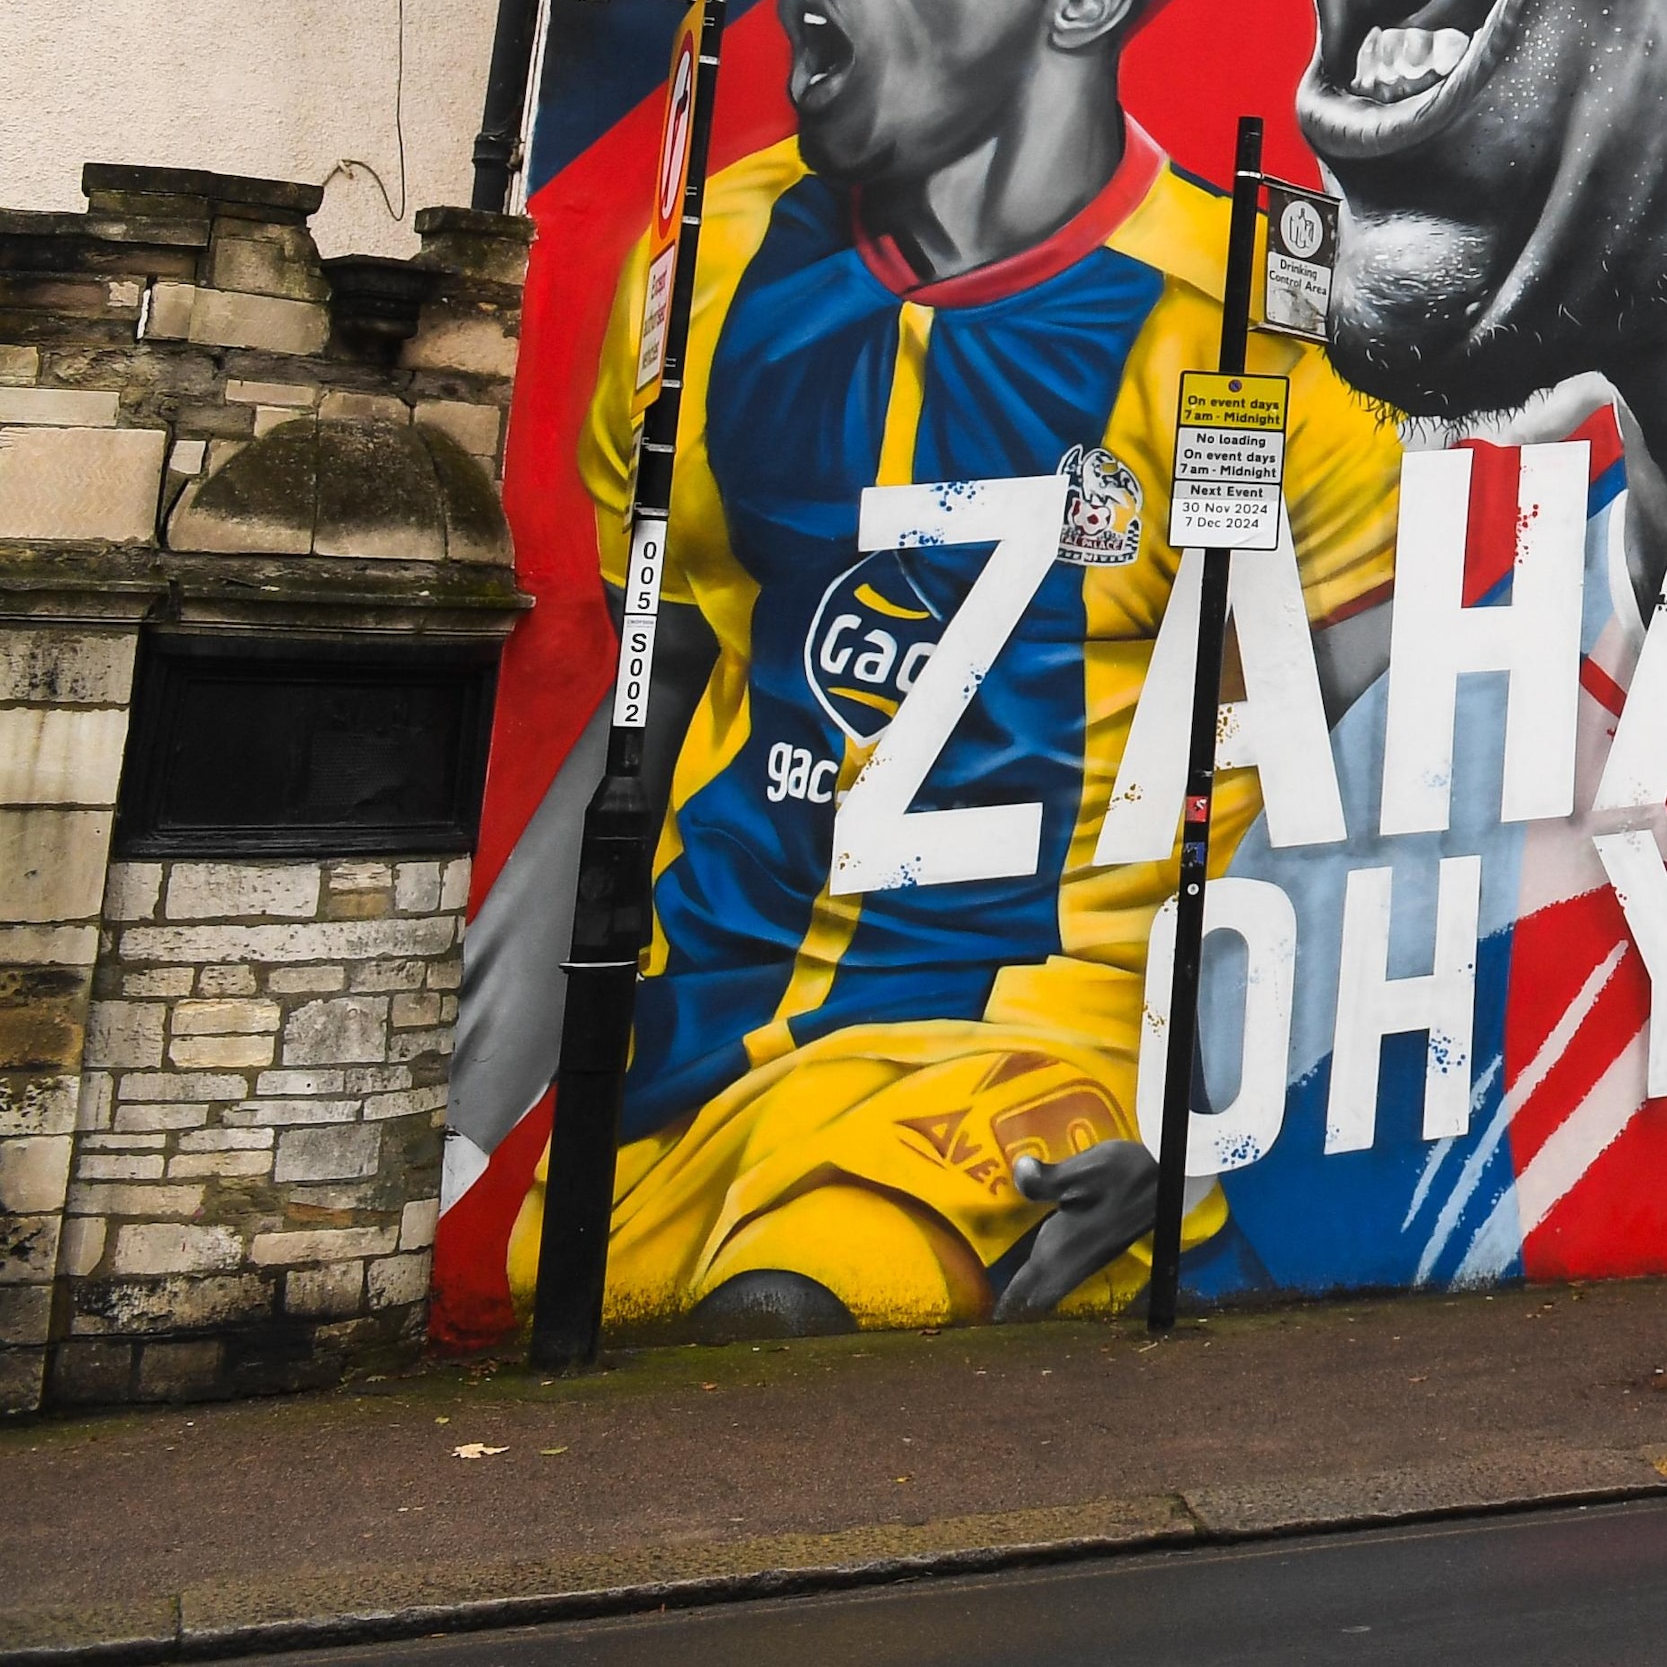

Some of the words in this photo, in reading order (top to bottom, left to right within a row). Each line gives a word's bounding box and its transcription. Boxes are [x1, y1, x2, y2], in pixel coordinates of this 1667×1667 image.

[1280, 259, 1318, 281] Drinking
[1269, 270, 1302, 289] Control
[1305, 281, 1327, 296] Area
[1187, 395, 1206, 406] On
[1210, 397, 1246, 409] event
[1250, 399, 1280, 412] days
[1224, 412, 1281, 426] Midnight
[1196, 432, 1215, 445] No
[1219, 433, 1267, 449] loading
[1184, 448, 1202, 461] On
[1206, 450, 1243, 463] event
[1246, 452, 1276, 465] days
[1219, 465, 1277, 479] Midnight
[1190, 484, 1222, 497] Next
[1226, 486, 1264, 499] Event
[1182, 502, 1200, 513] 30
[1204, 502, 1231, 514] Nov
[1234, 503, 1269, 515] 2024
[1185, 516, 1193, 527] 7
[1197, 517, 1221, 528] Dec
[1225, 518, 1260, 529] 2024
[1081, 537, 1122, 551] PALACE
[1136, 855, 1482, 1178] OH
